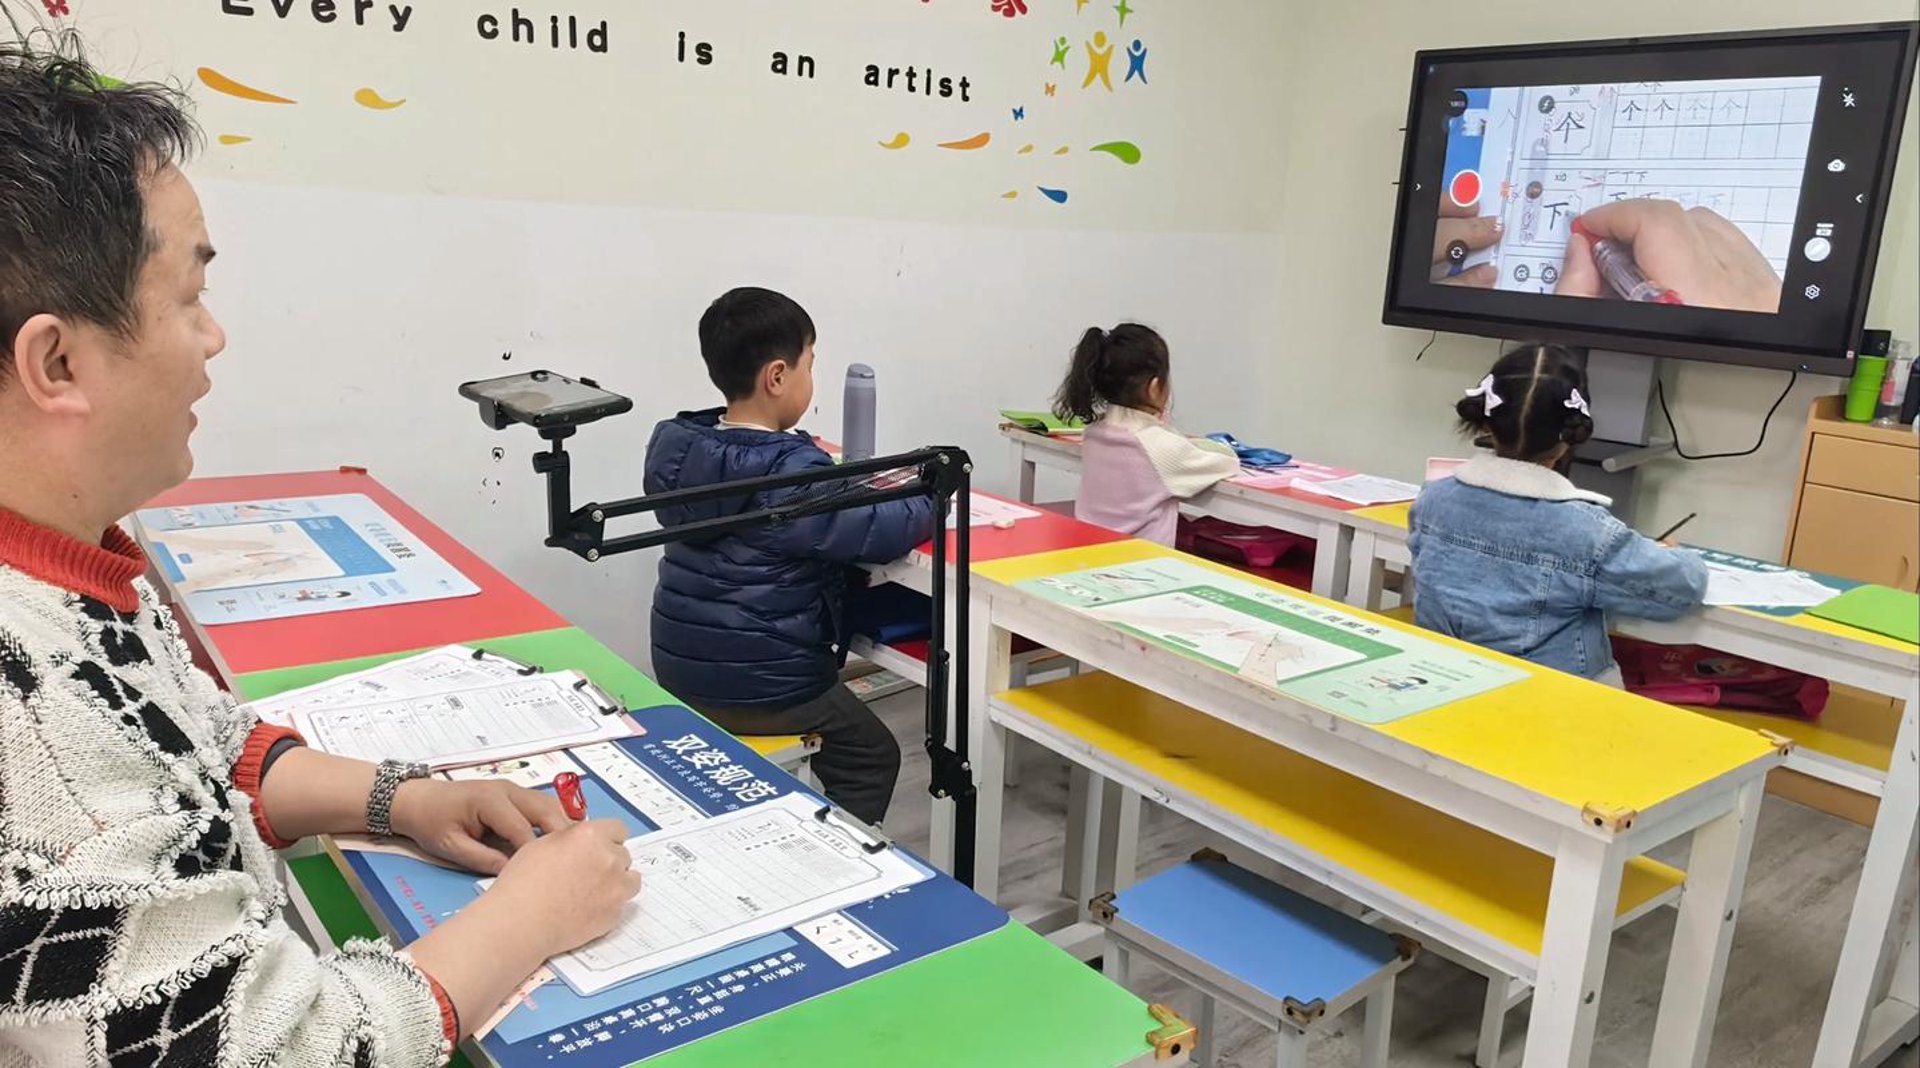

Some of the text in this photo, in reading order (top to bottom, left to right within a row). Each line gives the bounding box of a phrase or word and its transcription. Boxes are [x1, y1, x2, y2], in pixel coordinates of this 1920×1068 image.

[477, 8, 608, 53] child
[678, 31, 713, 66] is
[771, 51, 815, 79] an
[864, 64, 970, 102] artist
[1554, 112, 1585, 143] 个
[1544, 202, 1569, 230] 下
[661, 733, 778, 802] 双姿规范
